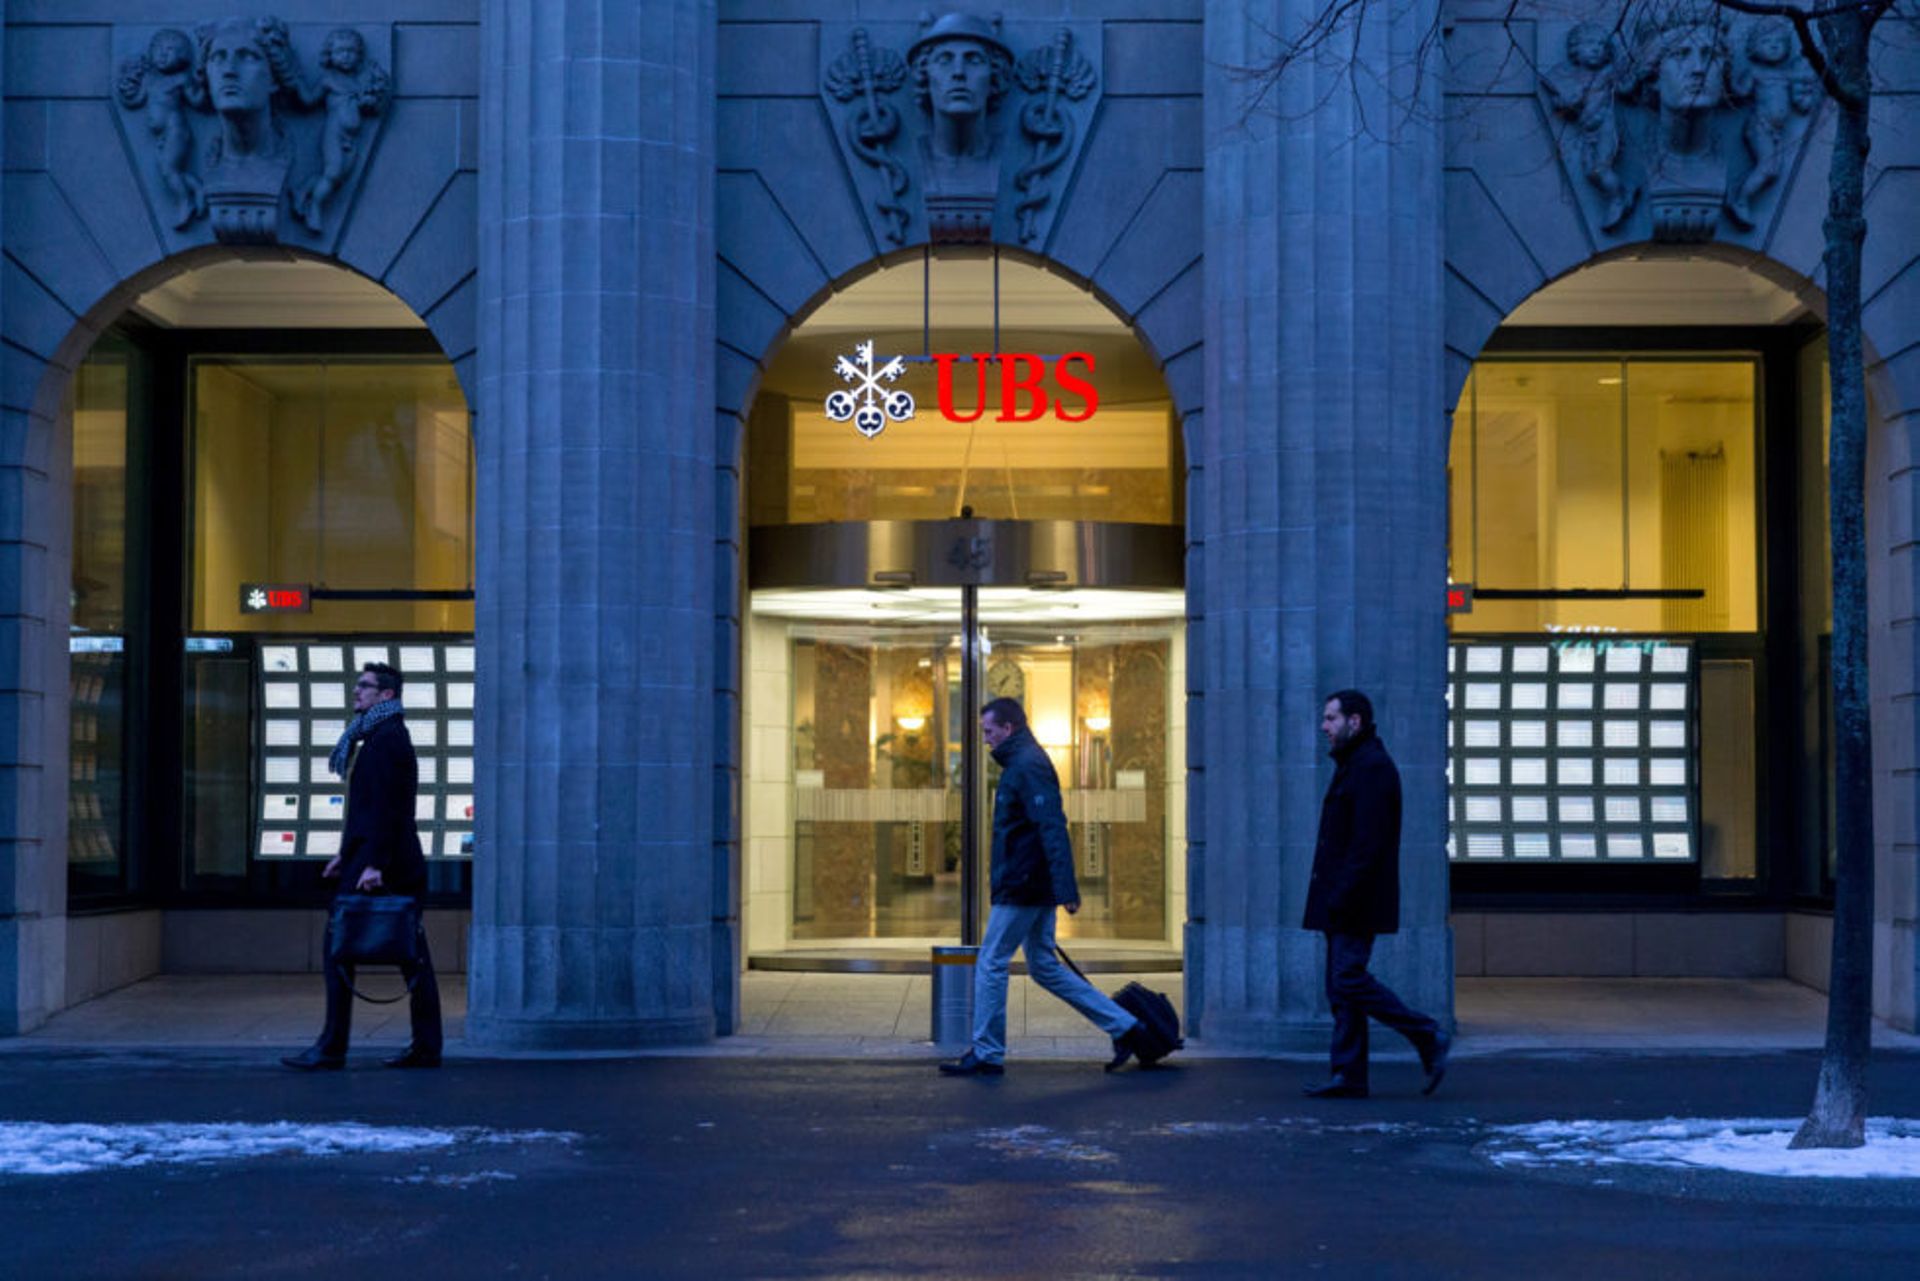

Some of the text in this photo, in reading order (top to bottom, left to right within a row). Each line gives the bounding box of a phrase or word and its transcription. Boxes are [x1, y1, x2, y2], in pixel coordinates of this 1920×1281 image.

[932, 352, 1099, 423] UBS
[947, 537, 991, 569] 45
[268, 590, 302, 607] UBS
